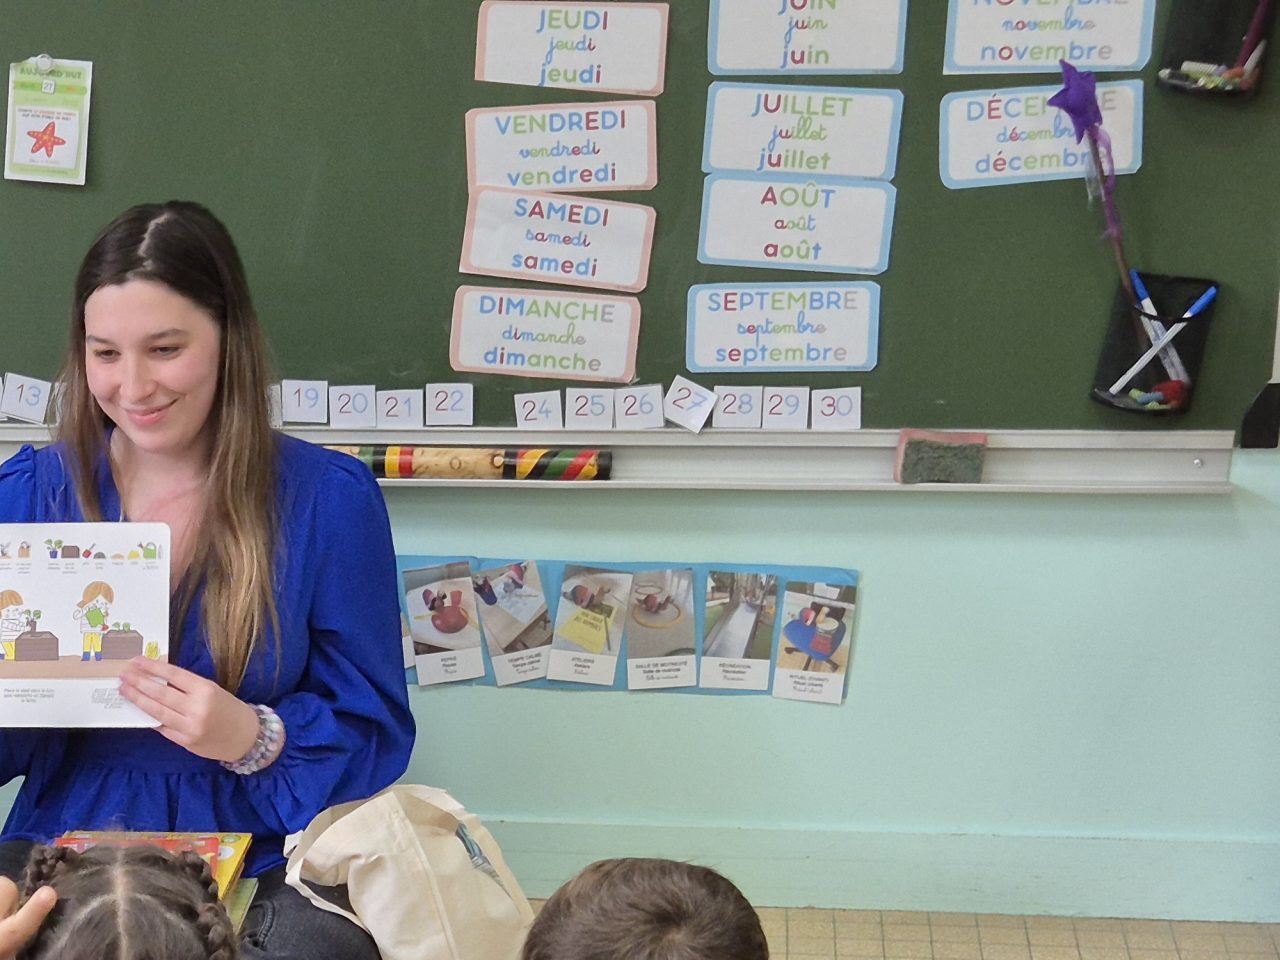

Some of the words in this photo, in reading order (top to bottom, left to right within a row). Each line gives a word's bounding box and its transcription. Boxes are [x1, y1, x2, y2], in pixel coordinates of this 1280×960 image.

[536, 9, 608, 33] JEUDI
[1002, 5, 1095, 31] novembre
[784, 16, 828, 45] juin
[545, 35, 596, 64] jeudi
[780, 45, 830, 69] juin
[981, 45, 1113, 61] novembre
[538, 63, 602, 87] jeudi
[751, 93, 853, 117] JUILLET
[966, 90, 1118, 121] DÉCEE
[495, 110, 626, 135] VENDREDI
[768, 116, 828, 152] juillet
[519, 140, 601, 159] vendredi
[756, 148, 831, 171] juillet
[507, 163, 616, 186] vendredi
[760, 181, 836, 208] AOÛT
[514, 198, 609, 227] SAMEDI
[774, 214, 816, 231] août
[526, 229, 591, 248] samedi
[763, 239, 822, 260] août
[511, 253, 598, 277] samedi
[479, 295, 615, 323] DIMANCHE
[707, 290, 858, 312] SEPTEMBRE
[502, 322, 587, 345] dimanche
[737, 310, 826, 348] septembre
[483, 347, 601, 372] dimanche
[715, 343, 847, 366] septembre
[17, 383, 42, 406] 13
[294, 387, 319, 409] 19
[338, 393, 369, 414] 20
[385, 397, 412, 417] 21
[435, 389, 464, 412] 22
[522, 400, 552, 421] 24
[575, 394, 606, 416] 25
[624, 394, 654, 416] 26
[672, 386, 708, 412] 27
[722, 393, 754, 415] 28
[768, 394, 799, 416] 29
[821, 394, 853, 417] 30
